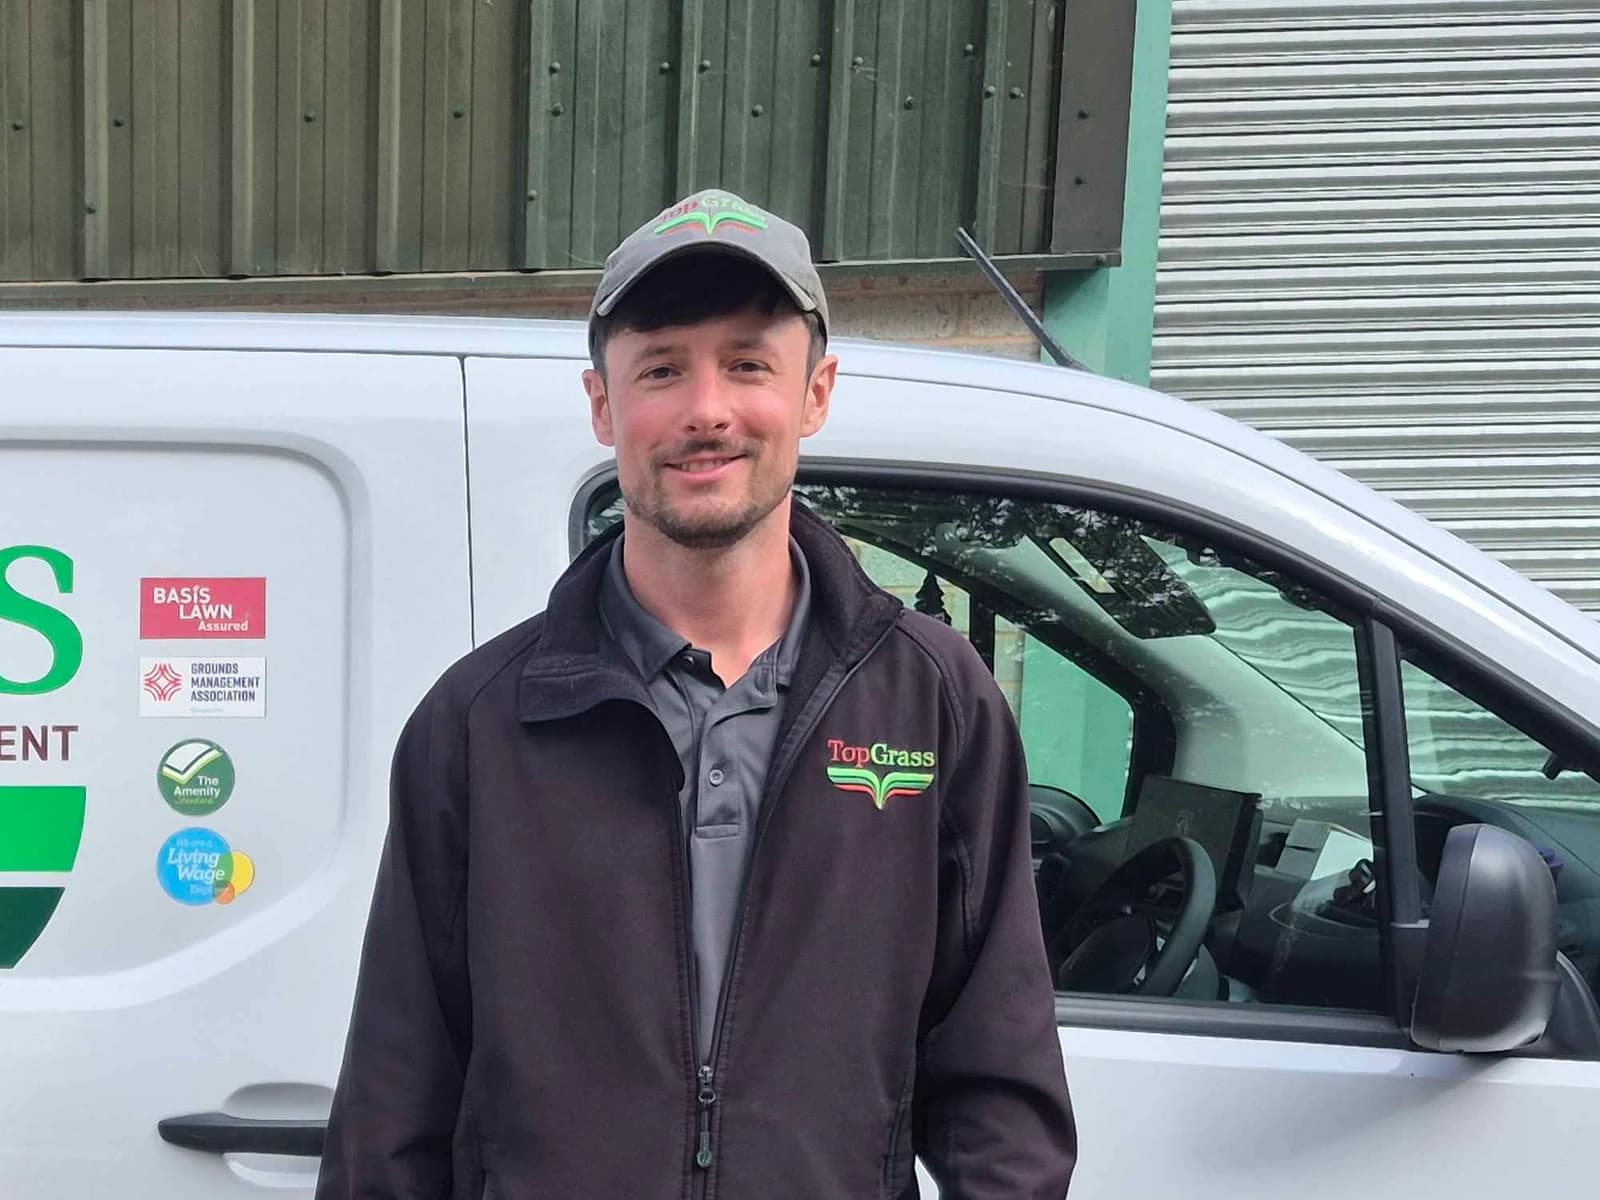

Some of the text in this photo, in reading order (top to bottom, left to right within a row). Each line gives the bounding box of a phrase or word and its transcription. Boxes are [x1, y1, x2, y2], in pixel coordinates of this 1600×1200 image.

[179, 604, 232, 619] LAWN
[197, 620, 248, 631] Assured
[191, 663, 239, 675] GROUNDS
[191, 677, 260, 688] MANAGEMENT
[191, 690, 255, 702] ASSOCIATION
[827, 739, 936, 768] TopGrass
[197, 775, 219, 786] The
[173, 786, 221, 799] Amenity
[167, 848, 219, 867] Living
[176, 864, 225, 884] Wage
